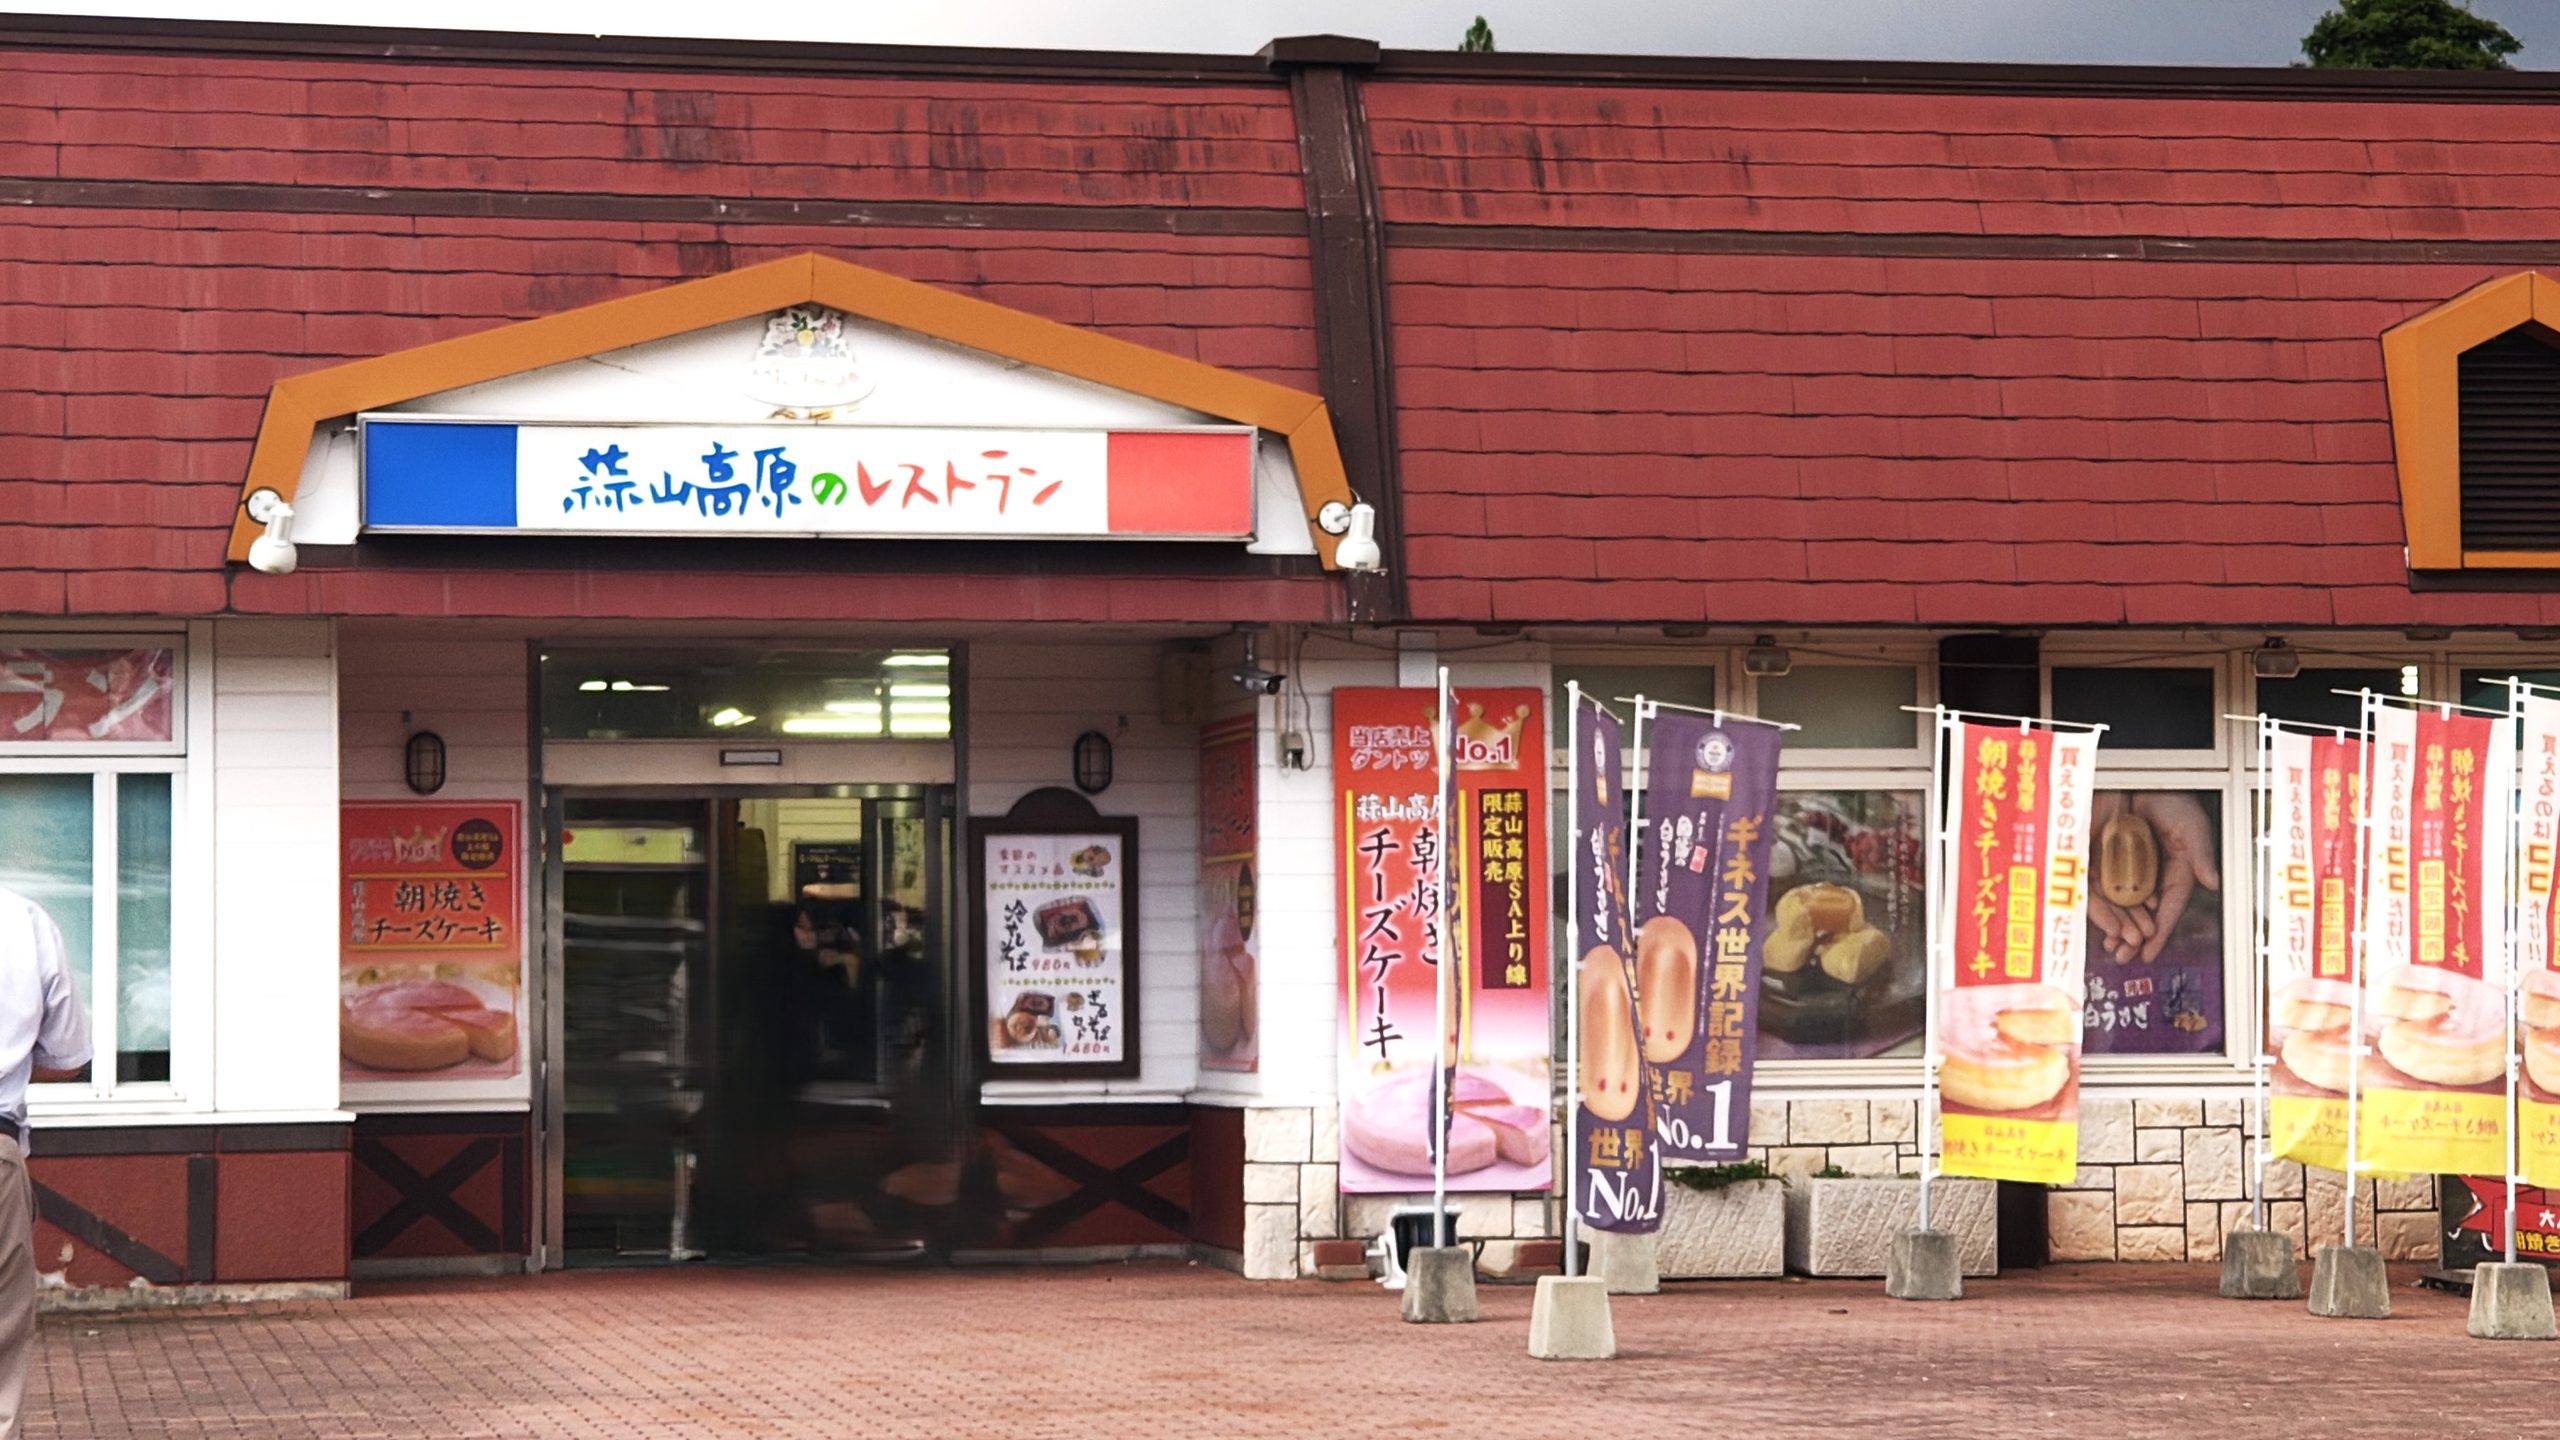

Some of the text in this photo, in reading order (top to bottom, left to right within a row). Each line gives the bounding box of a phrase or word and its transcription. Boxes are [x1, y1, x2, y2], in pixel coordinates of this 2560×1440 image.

[563, 442, 1062, 518] 蒜山高原のレストラン
[1351, 749, 1430, 771] ダントツ
[1483, 793, 1504, 882] 限定販売
[1969, 737, 2008, 979] 朝焼きチーズケーキ
[368, 915, 502, 943] チーズケーキ
[395, 881, 486, 913] 朝焼き
[1505, 793, 1528, 986] 蒜山高原SA上り線
[1359, 827, 1403, 1059] チーズケーキ
[1705, 815, 1762, 1076] ギネス世界記録
[1586, 1139, 1659, 1221] No.1
[1588, 1127, 1644, 1170] 世界
[2539, 1209, 2560, 1228] 大
